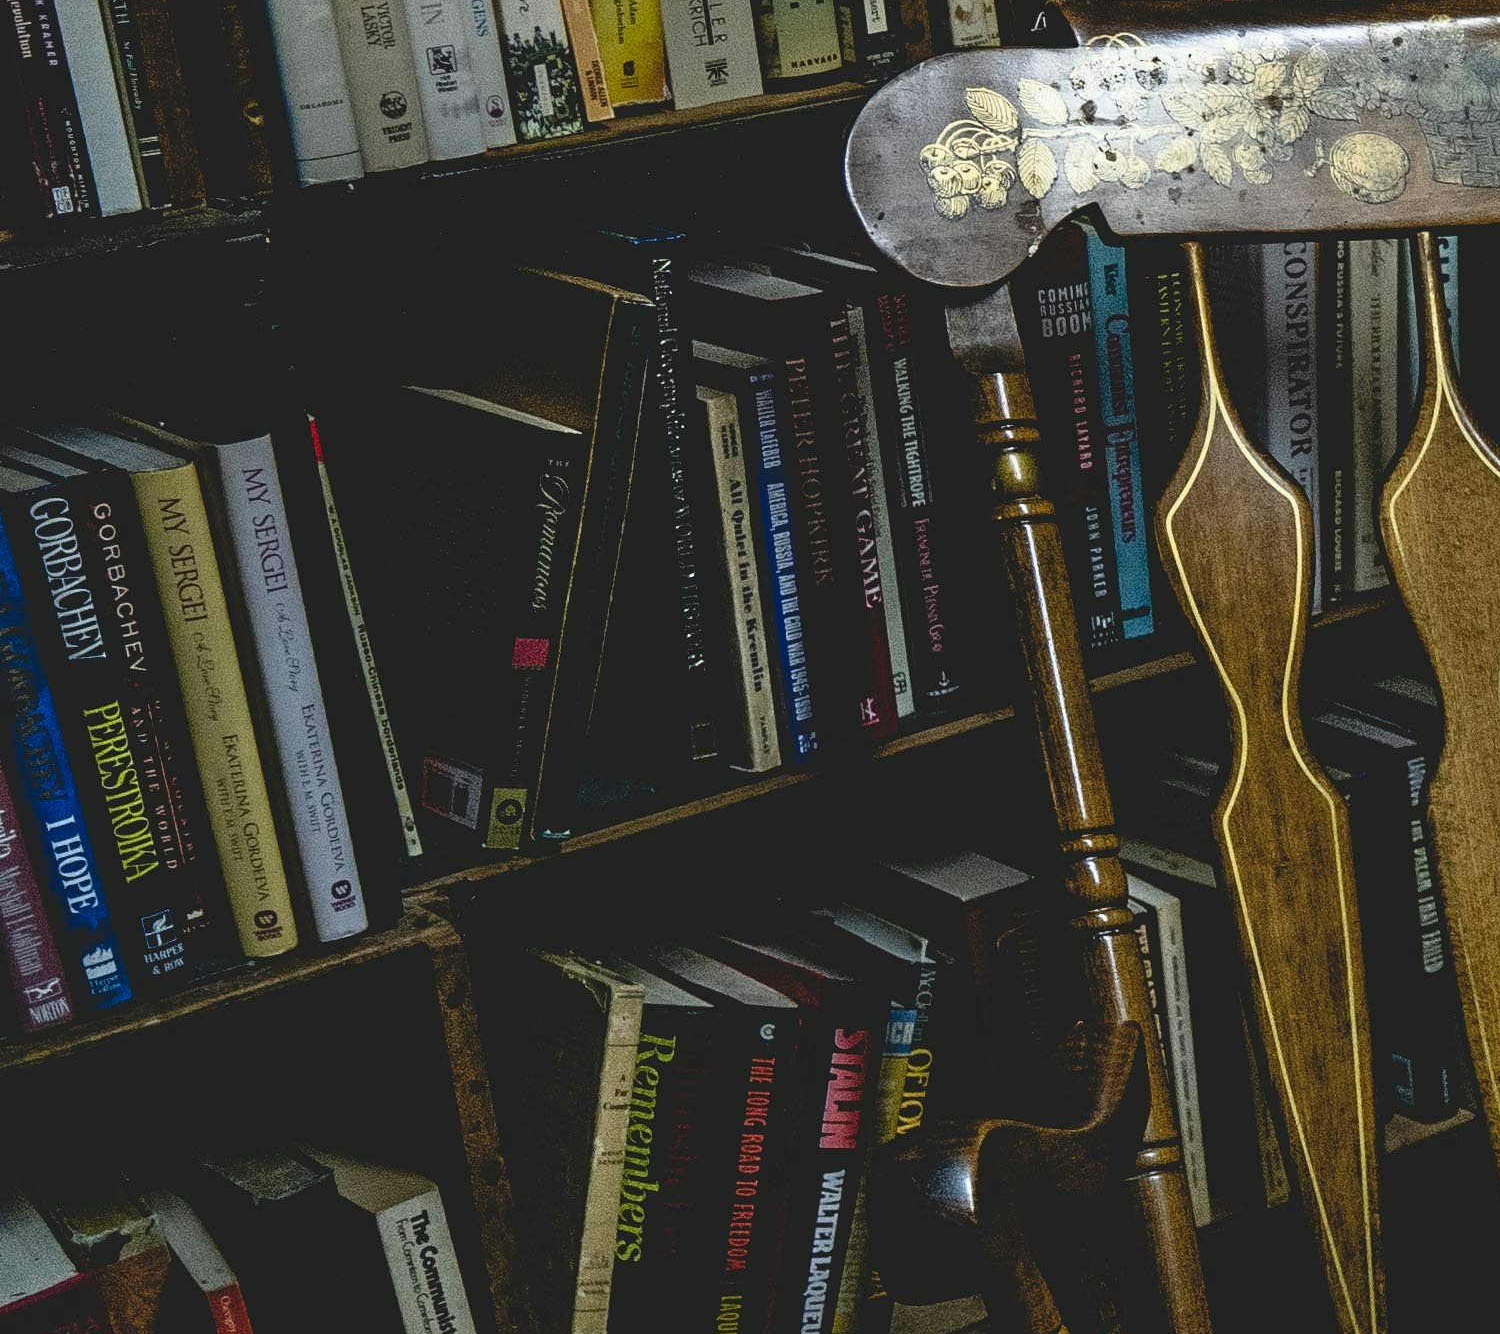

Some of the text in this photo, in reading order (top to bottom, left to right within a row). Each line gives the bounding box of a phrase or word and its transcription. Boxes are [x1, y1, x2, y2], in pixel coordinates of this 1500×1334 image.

[30, 497, 116, 660] GORBACHEV
[93, 502, 147, 671] GORBACHEV
[242, 468, 289, 593] MY SERGEI
[84, 701, 160, 882] PERESTROIKA
[617, 1035, 676, 1262] Remembers
[819, 1028, 864, 1149] STALIN
[812, 1169, 845, 1253] WALTER
